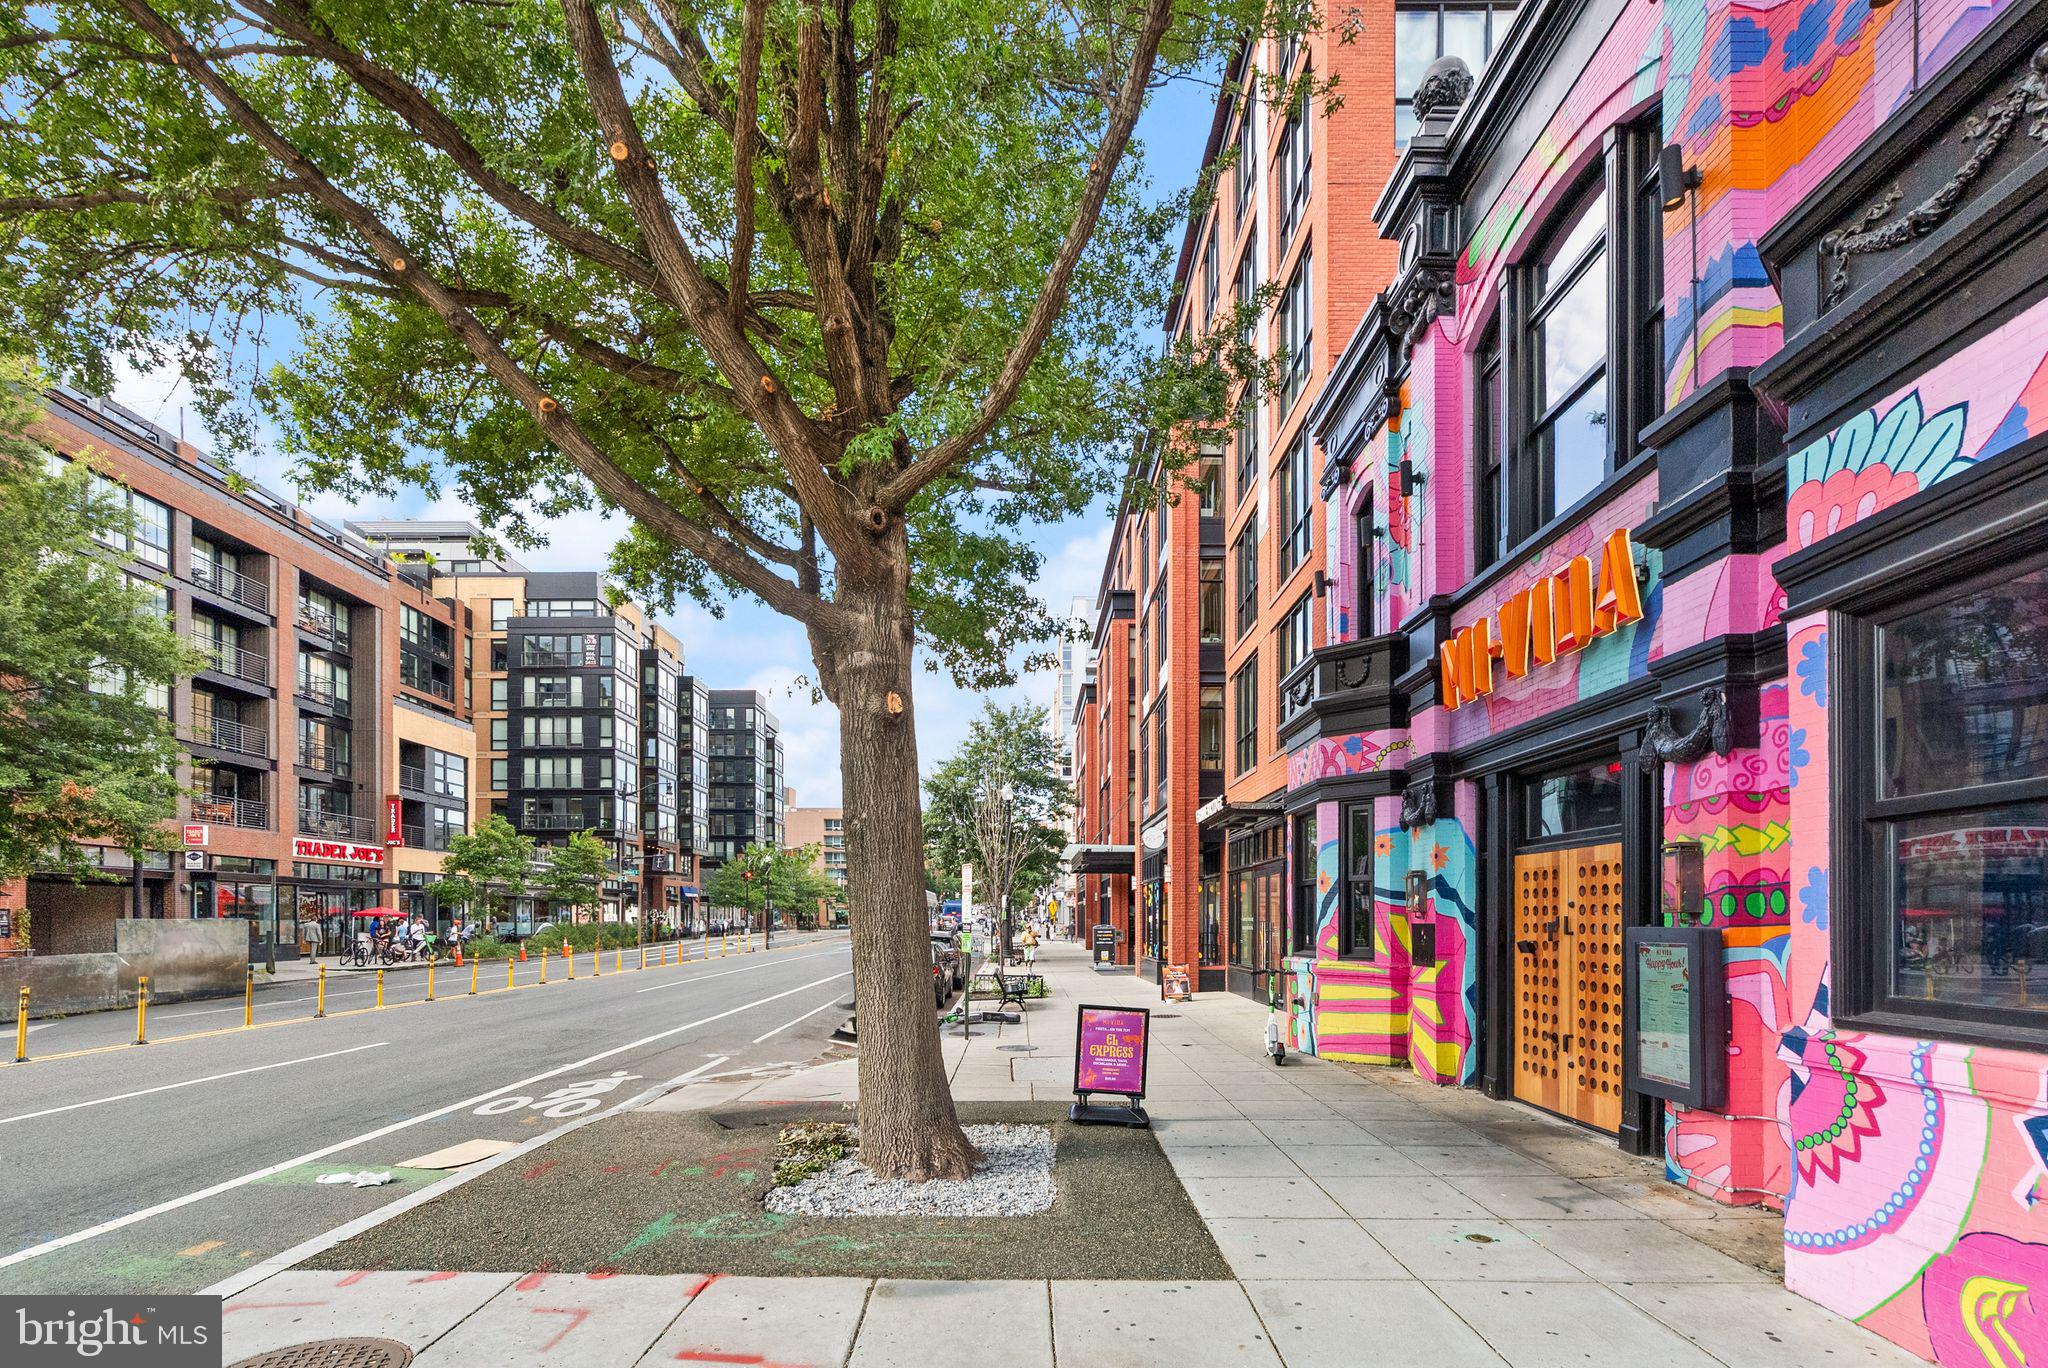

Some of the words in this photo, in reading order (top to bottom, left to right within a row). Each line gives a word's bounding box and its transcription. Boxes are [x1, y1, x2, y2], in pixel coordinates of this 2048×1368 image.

[296, 841, 348, 860] TRADER
[350, 846, 384, 863] JOE'S
[1105, 1033, 1119, 1046] EL
[1089, 1045, 1134, 1058] EXPRESS
